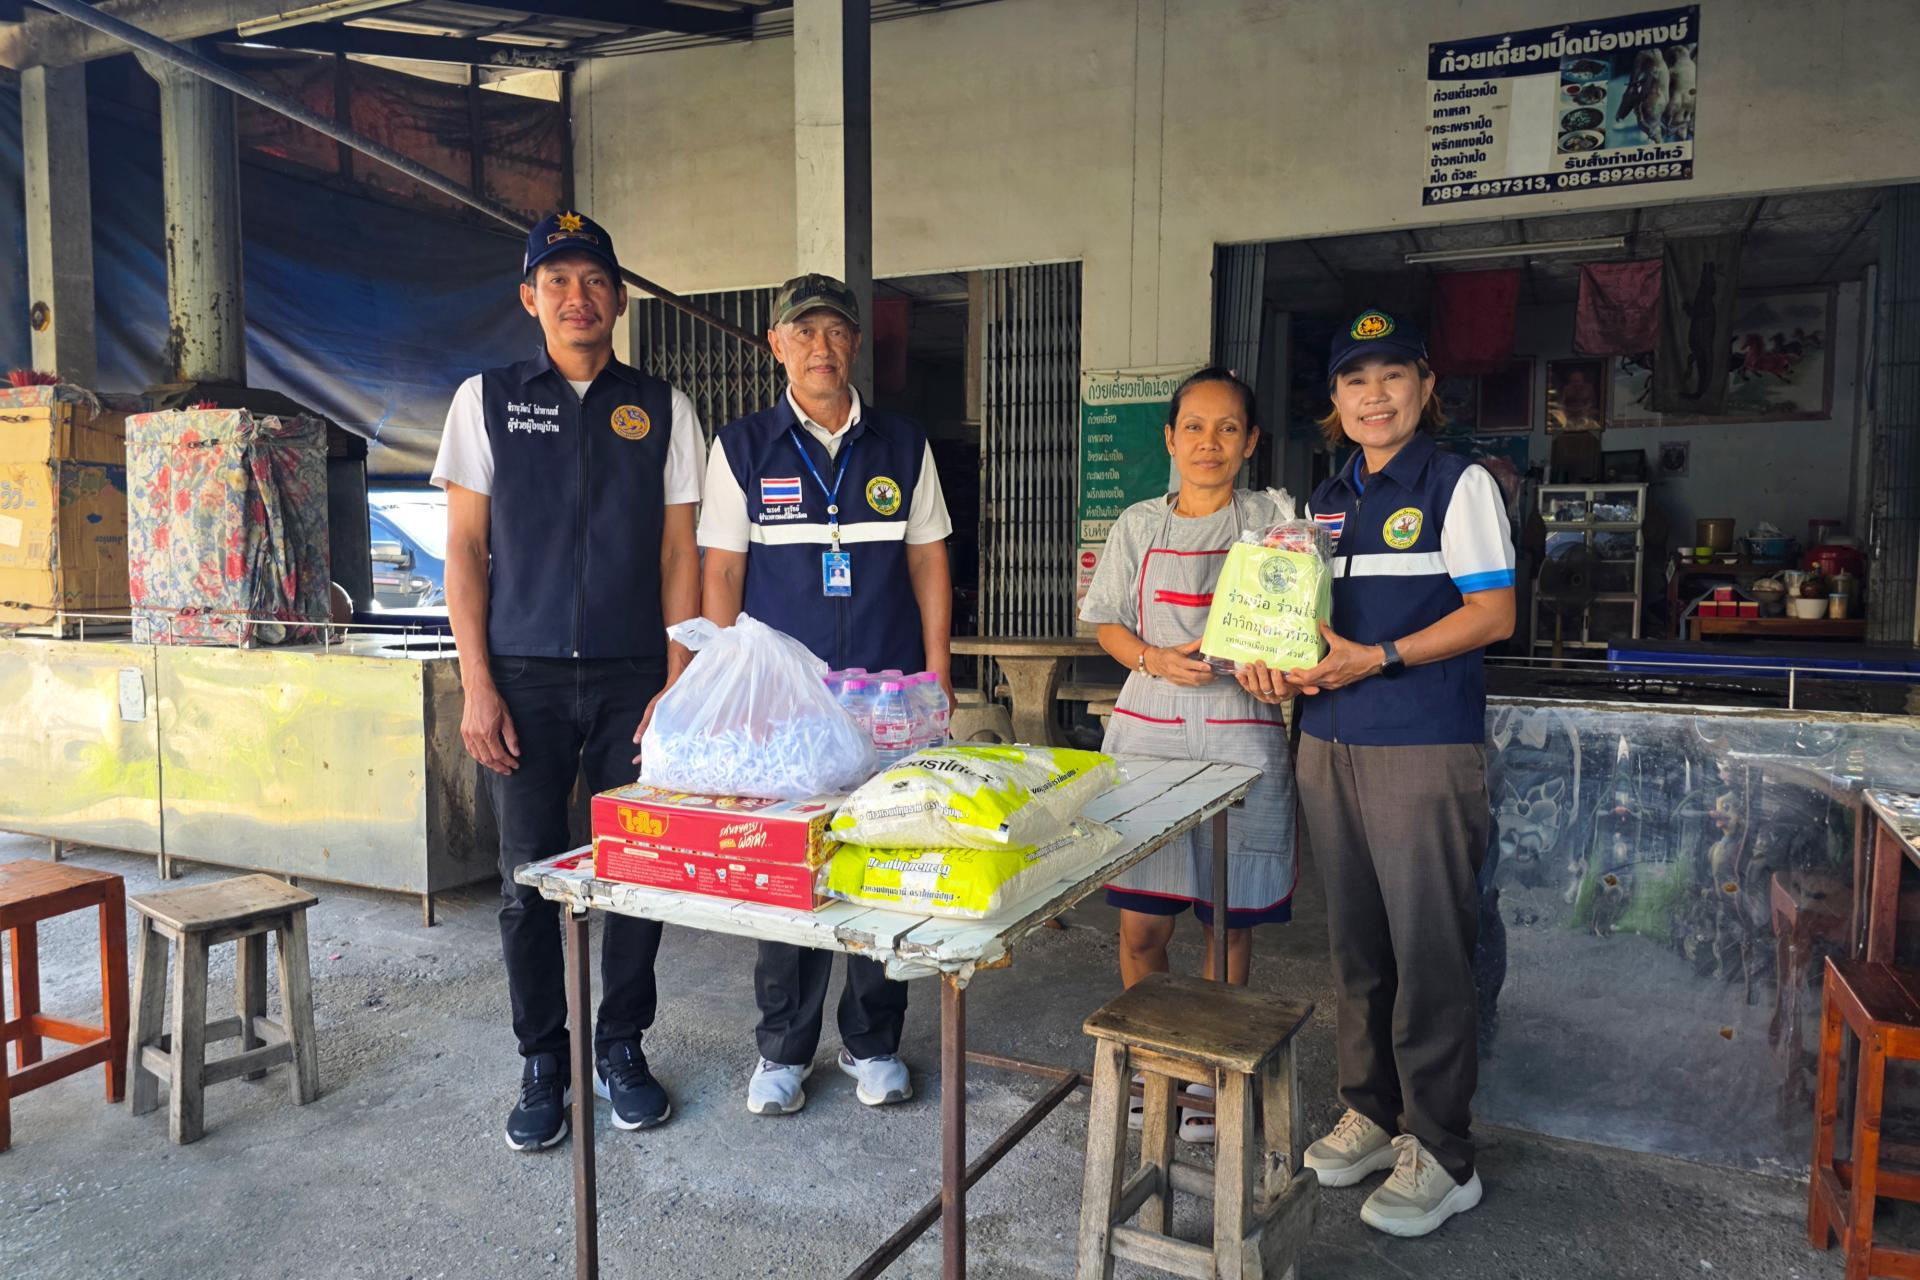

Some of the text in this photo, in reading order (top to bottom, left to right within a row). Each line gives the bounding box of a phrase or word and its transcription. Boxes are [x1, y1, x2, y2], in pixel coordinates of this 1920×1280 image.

[1432, 103, 1471, 119] เกาเหลา
[1557, 163, 1683, 188] 086-8926652
